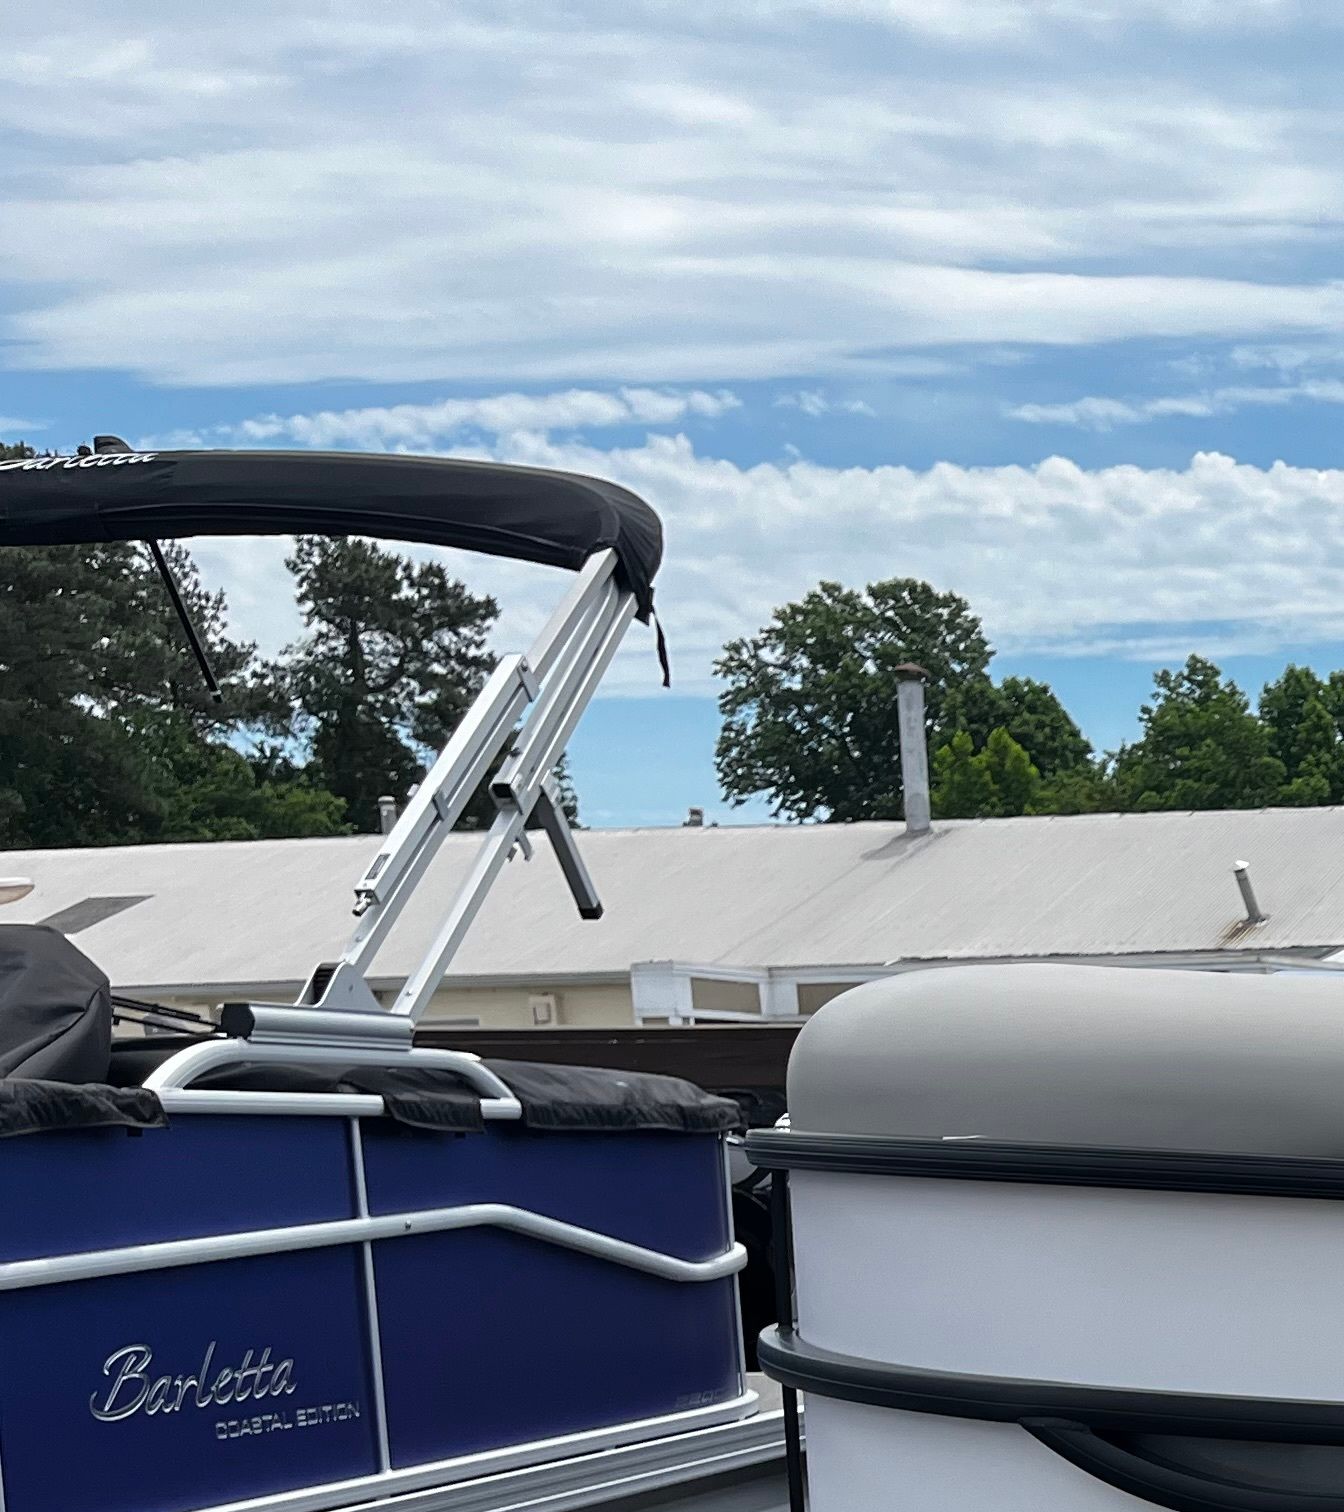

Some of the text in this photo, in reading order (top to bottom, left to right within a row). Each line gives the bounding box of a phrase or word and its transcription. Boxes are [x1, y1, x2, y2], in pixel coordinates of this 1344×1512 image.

[89, 1341, 297, 1422] Barletta
[215, 1401, 361, 1440] COASTAL EDITION
